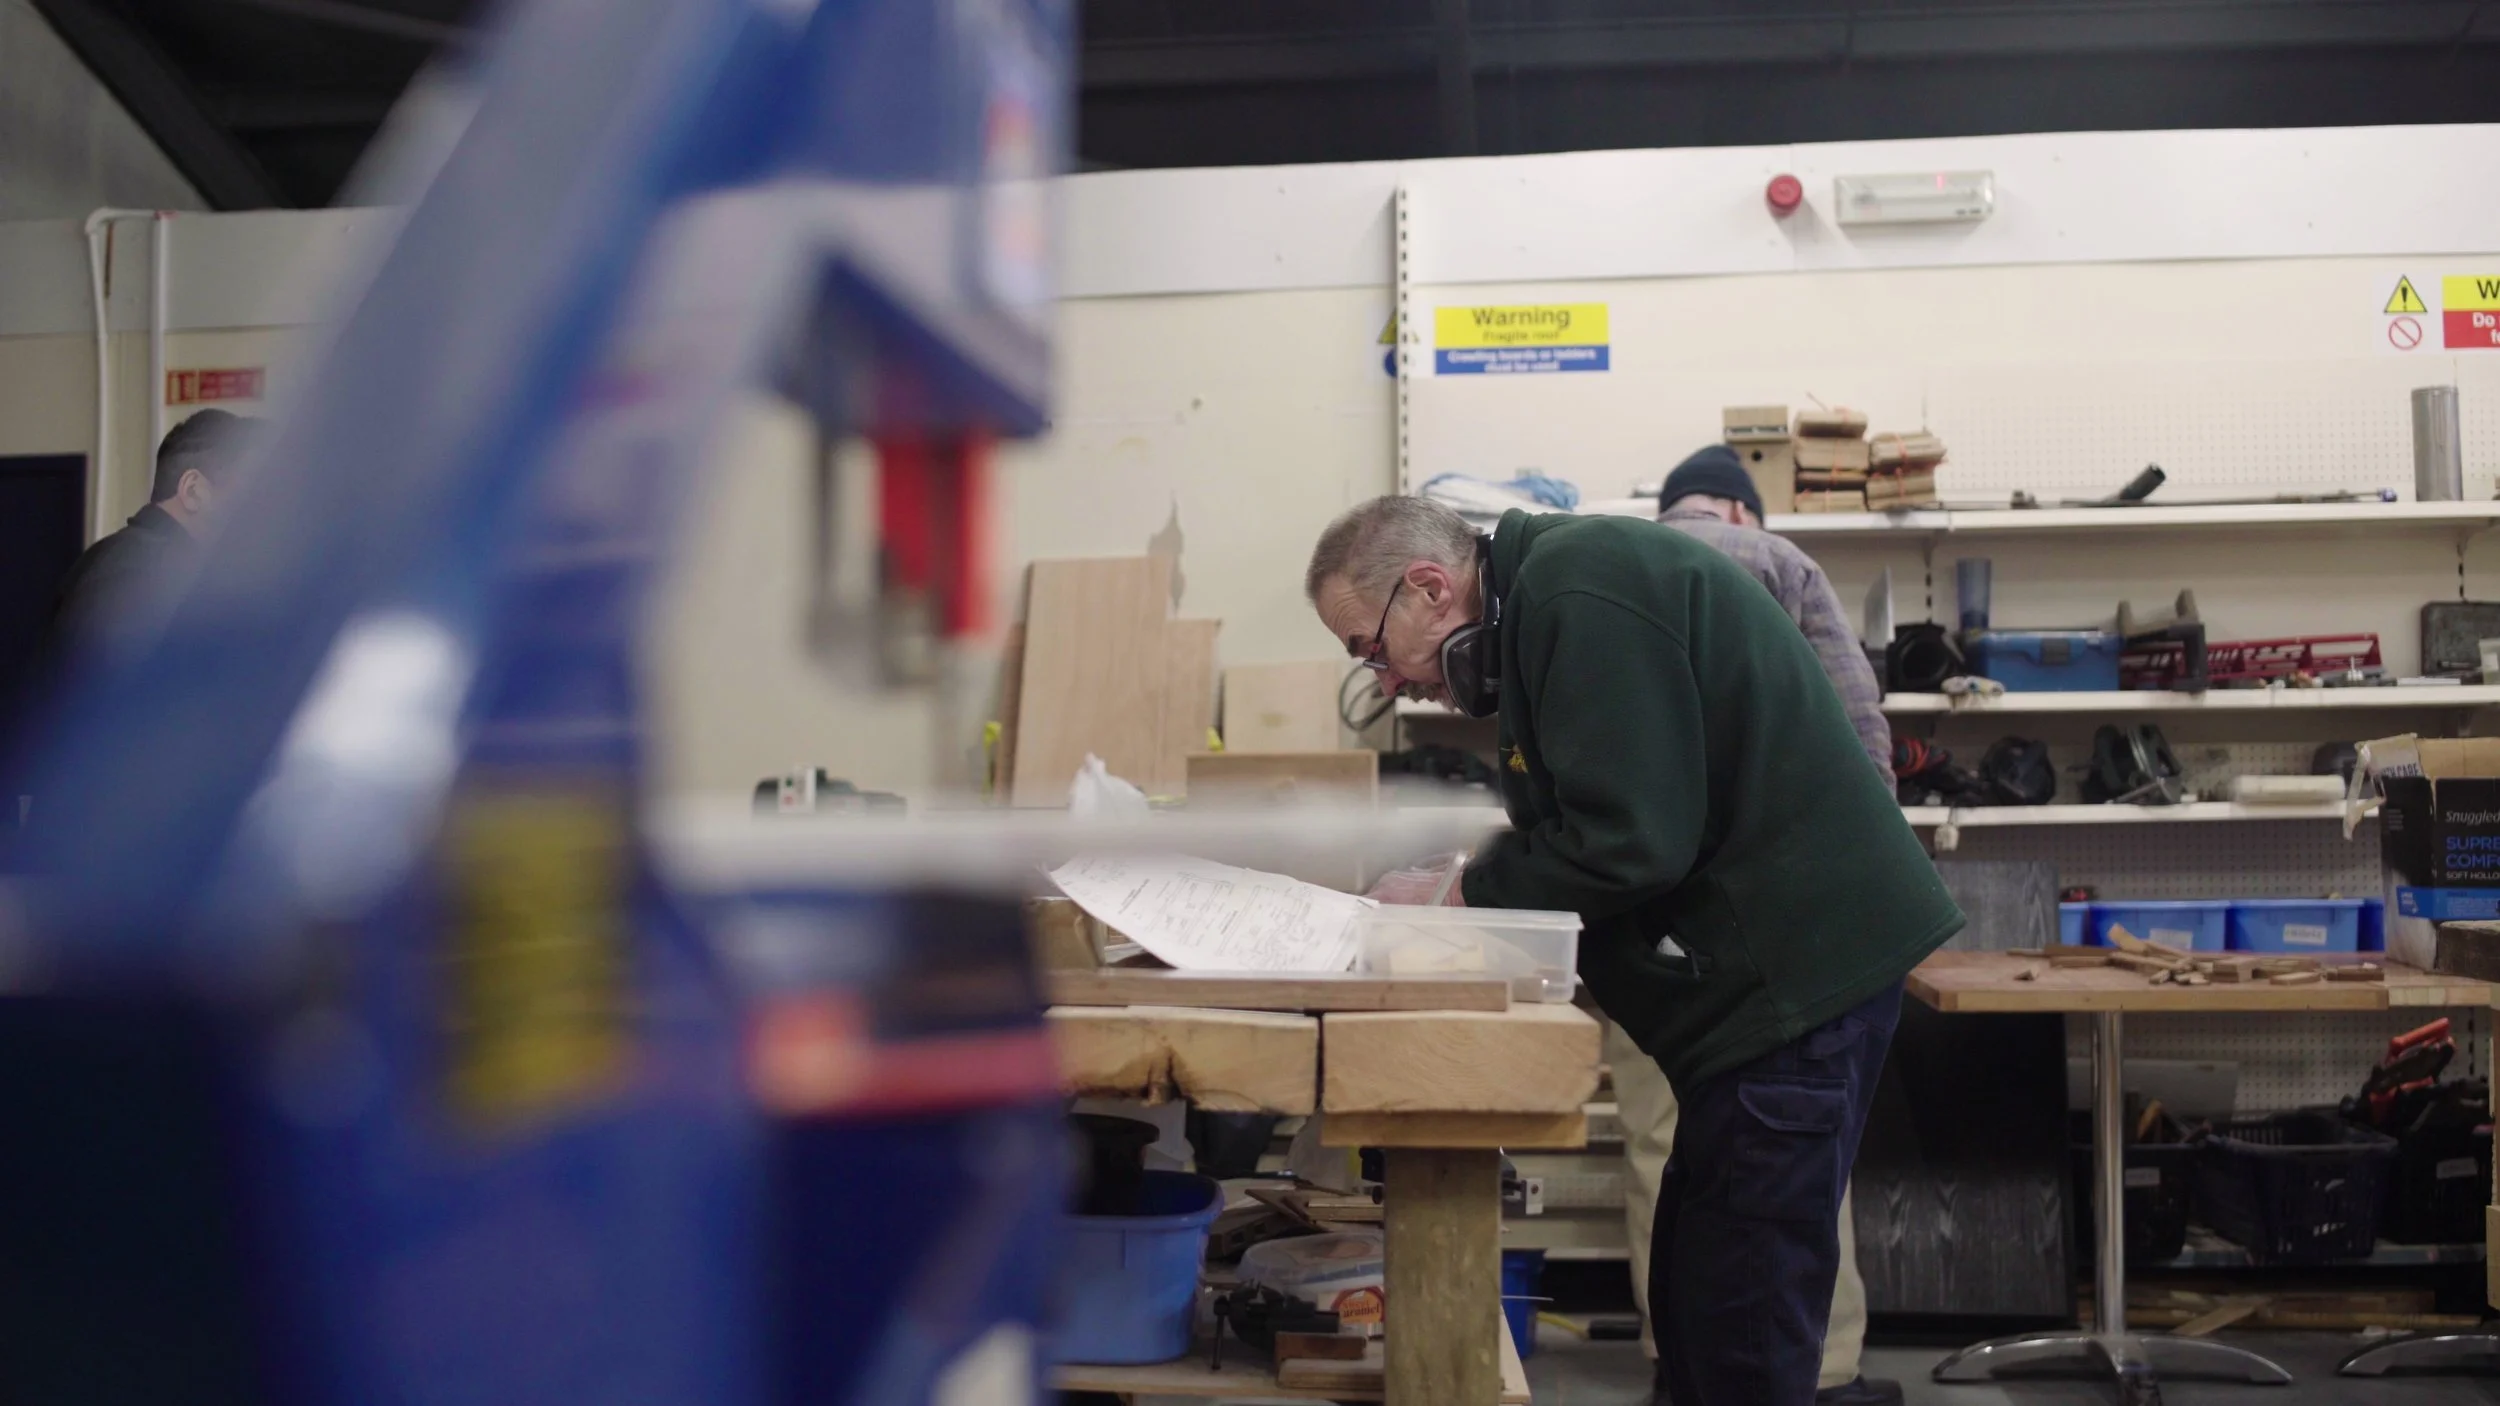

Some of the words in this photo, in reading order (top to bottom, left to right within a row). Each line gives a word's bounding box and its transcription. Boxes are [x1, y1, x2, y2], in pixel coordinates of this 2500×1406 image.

[1471, 307, 1570, 331] Warning
[2472, 312, 2496, 329] Do
[2446, 854, 2500, 868] COMF
[2446, 871, 2468, 880] SOFT
